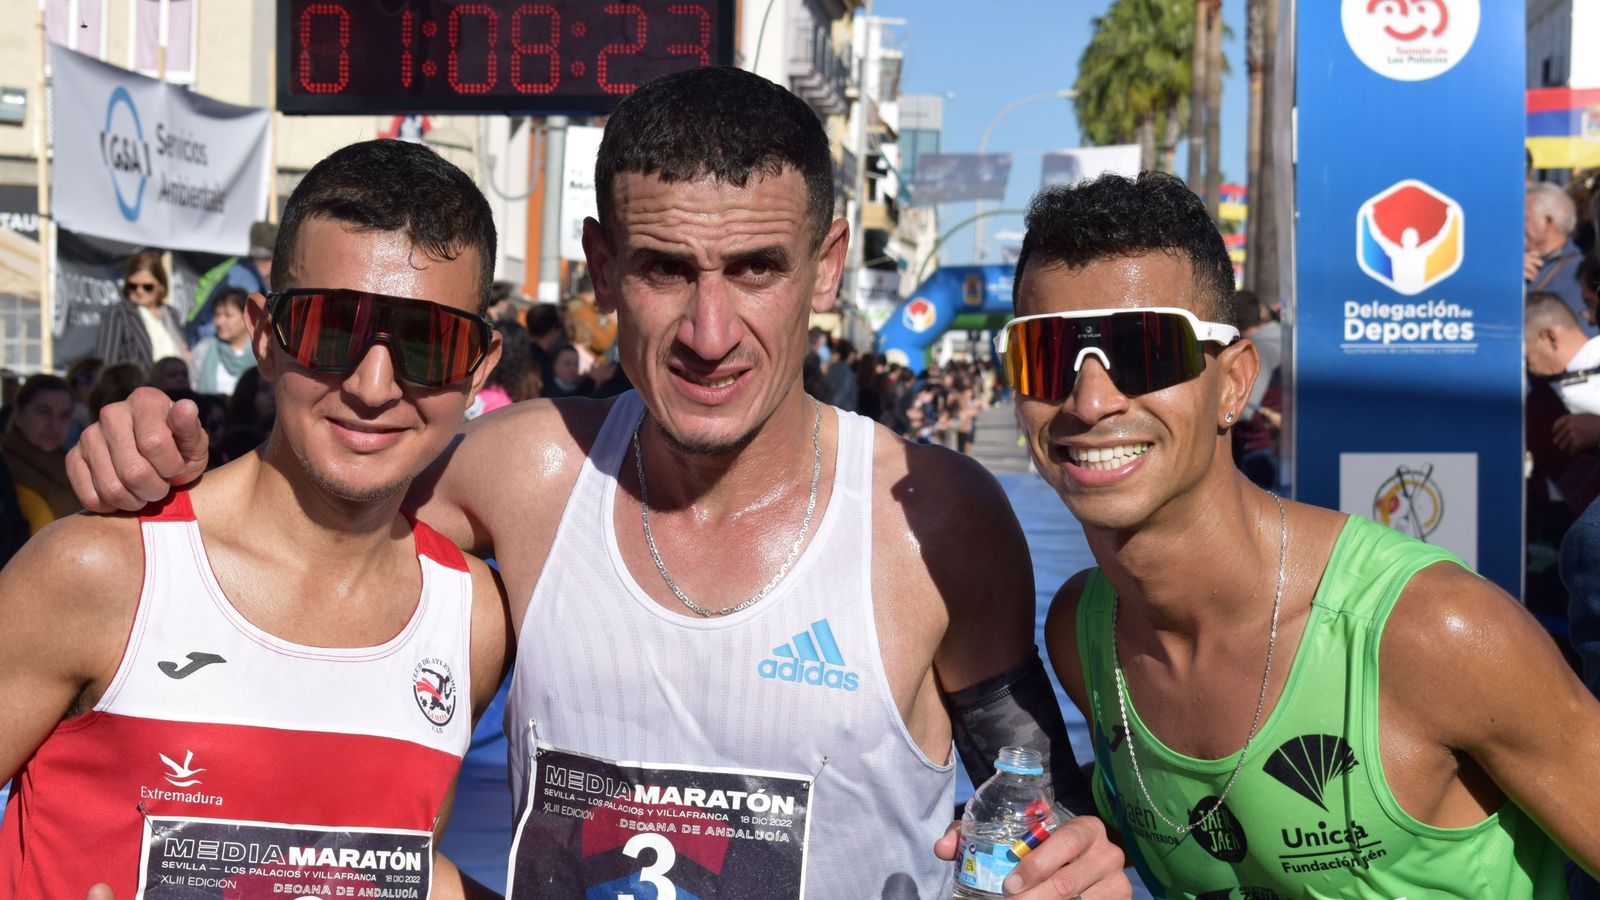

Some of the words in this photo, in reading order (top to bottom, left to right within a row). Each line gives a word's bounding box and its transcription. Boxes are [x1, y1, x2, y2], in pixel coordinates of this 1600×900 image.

[1344, 300, 1460, 321] Delegación
[1344, 318, 1475, 345] Deportes
[757, 657, 860, 692] adidas
[140, 785, 224, 806] Extremadura
[543, 787, 576, 802] SEVILLA
[588, 798, 603, 808] LOS
[604, 800, 645, 817] PALACIOS
[656, 808, 730, 823] VILLAFRANCA
[561, 803, 596, 821] EDICIÓN
[740, 815, 750, 825] 18
[751, 816, 768, 826] DIC
[769, 818, 793, 828] 2022
[619, 817, 678, 834] DECANA
[681, 823, 702, 835] DE
[704, 826, 791, 844] ANDALUCÍA
[161, 860, 207, 873] SEVILLA
[224, 865, 246, 875] LOS
[249, 868, 301, 879] PALACIOS
[304, 871, 310, 879] Y
[312, 871, 377, 882] VILLAFRANCA
[617, 832, 677, 900] 3
[1281, 856, 1360, 874] Fundación
[160, 874, 186, 886] XLIII
[187, 876, 237, 889] EDICIÓN
[393, 875, 404, 884] DIC
[405, 875, 421, 884] 2022
[273, 883, 332, 896] DECANA
[336, 885, 355, 896] DE
[357, 886, 418, 899] ANDALUCÍA
